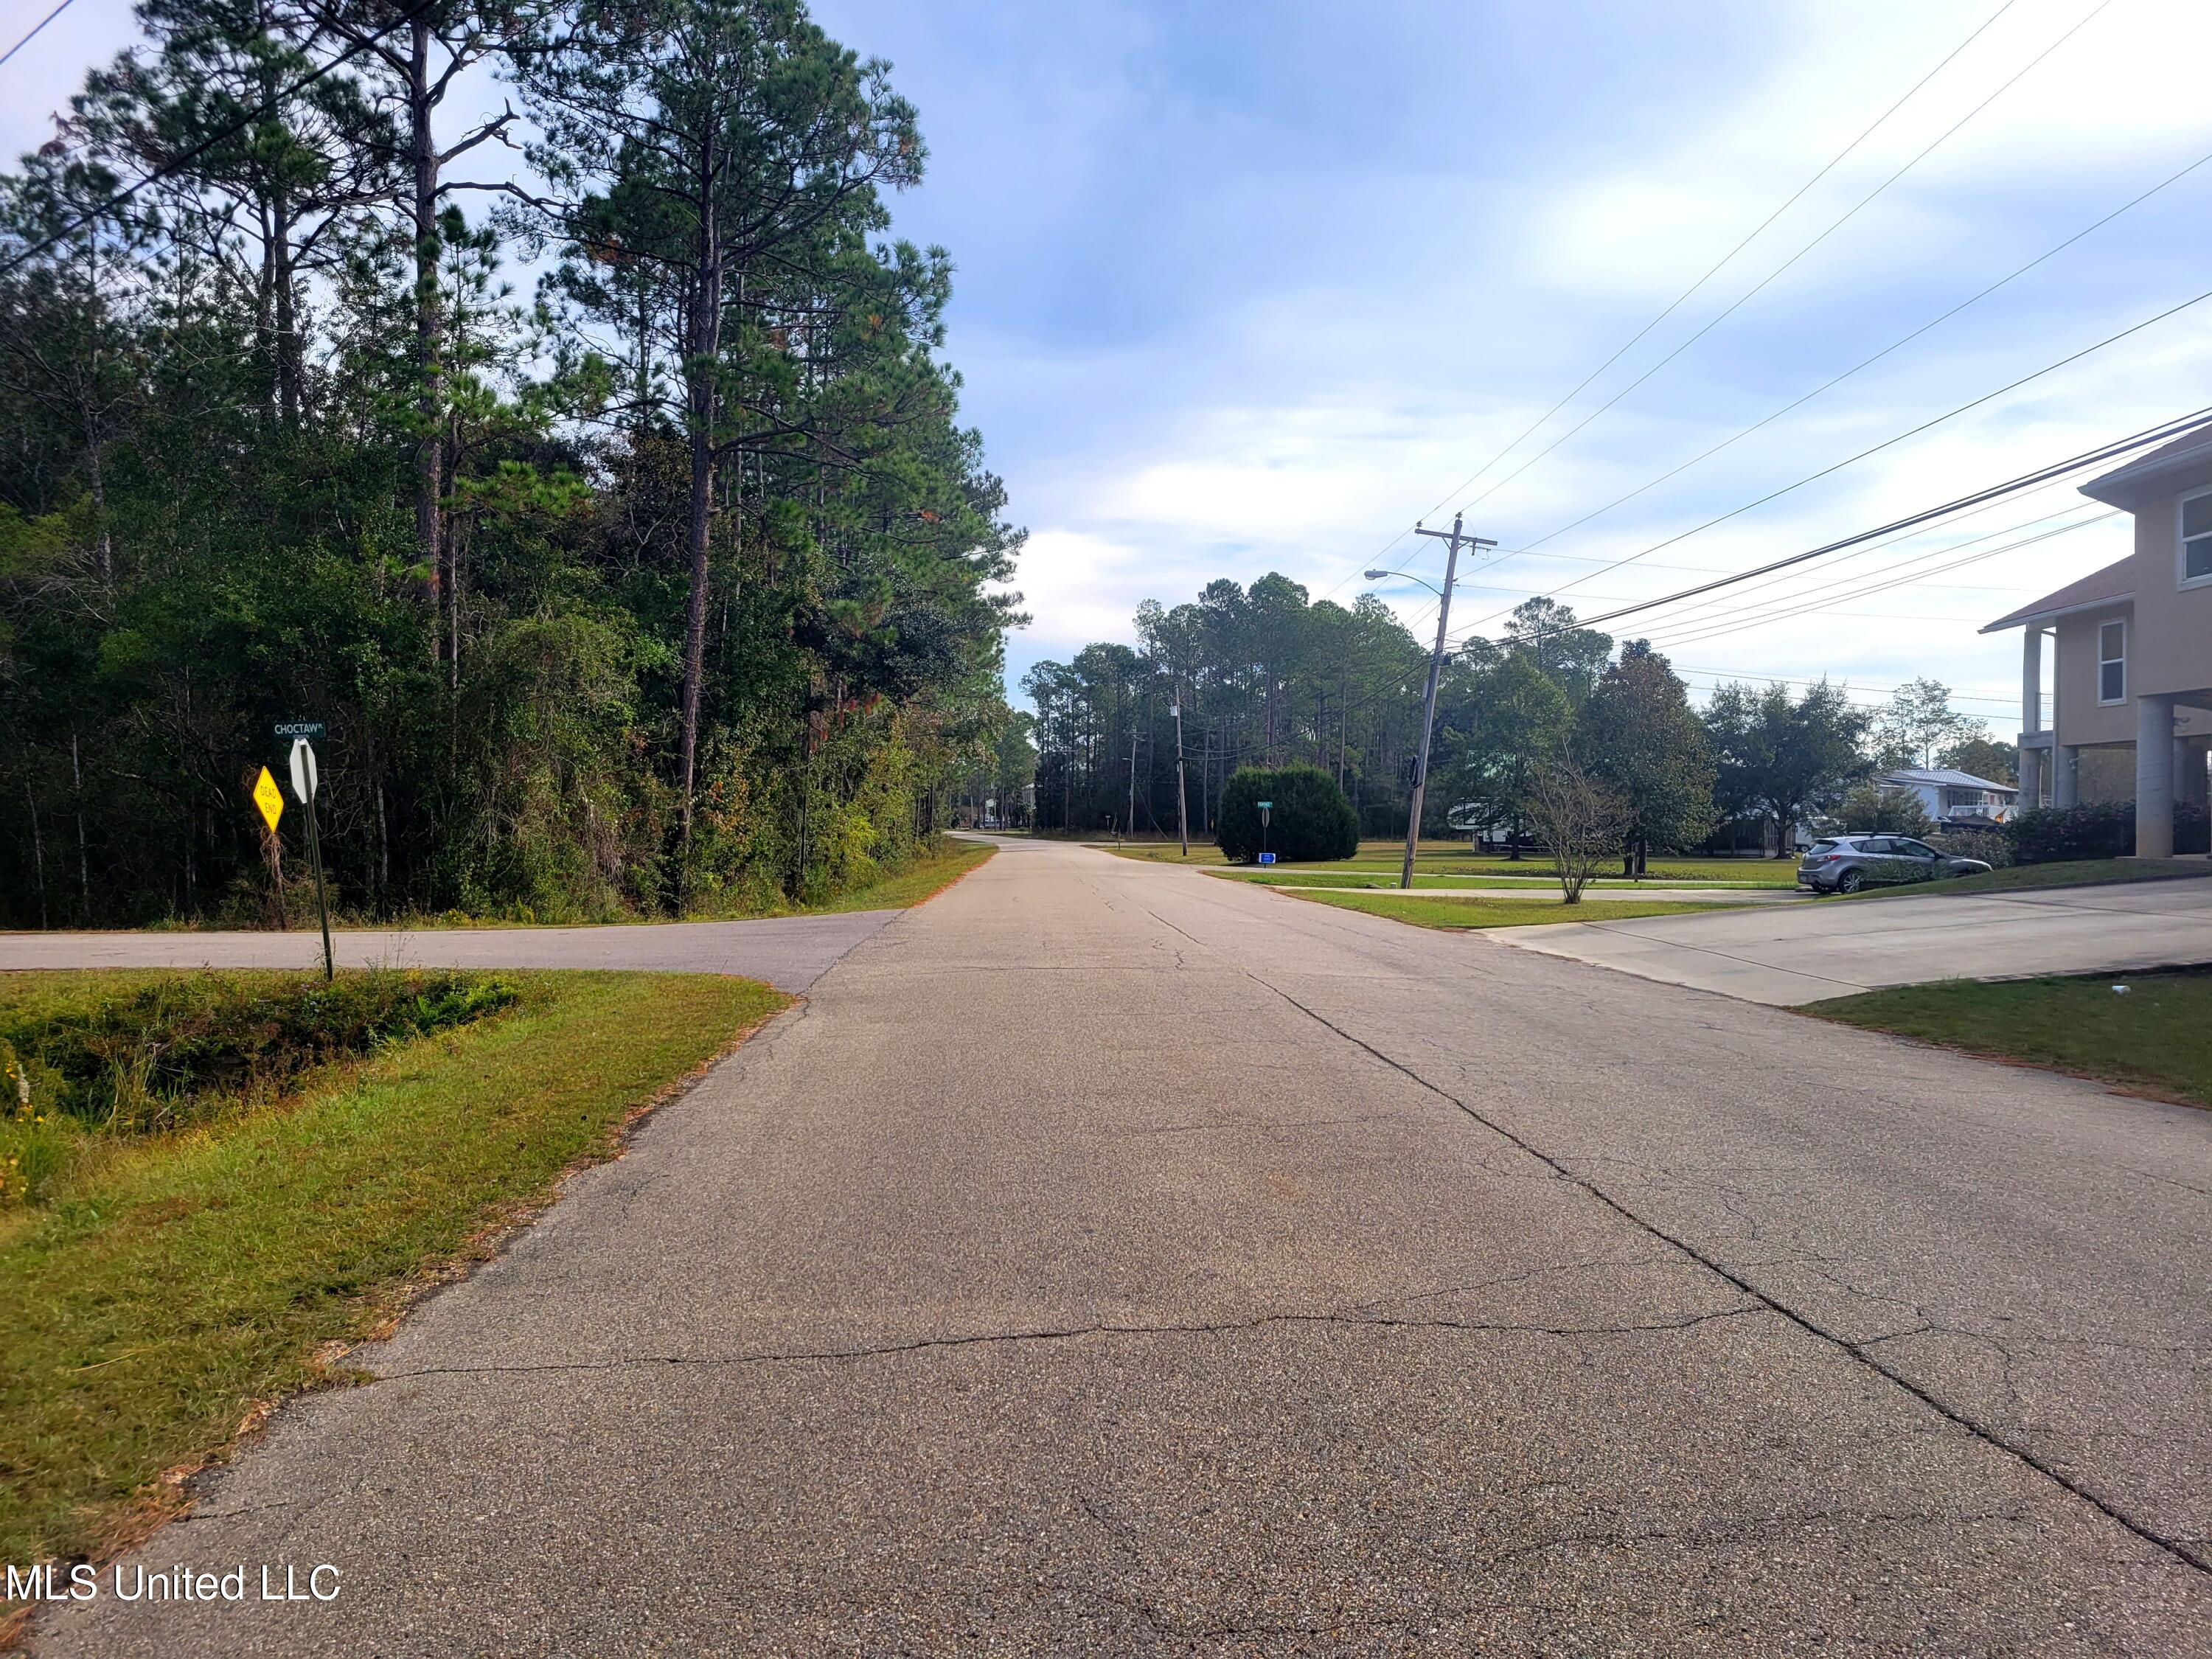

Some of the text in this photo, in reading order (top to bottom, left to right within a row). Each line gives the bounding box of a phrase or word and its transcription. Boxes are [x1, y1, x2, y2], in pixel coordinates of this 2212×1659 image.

[275, 723, 318, 734] CHOCTAW
[261, 786, 276, 799] DEAD
[265, 803, 276, 814] END
